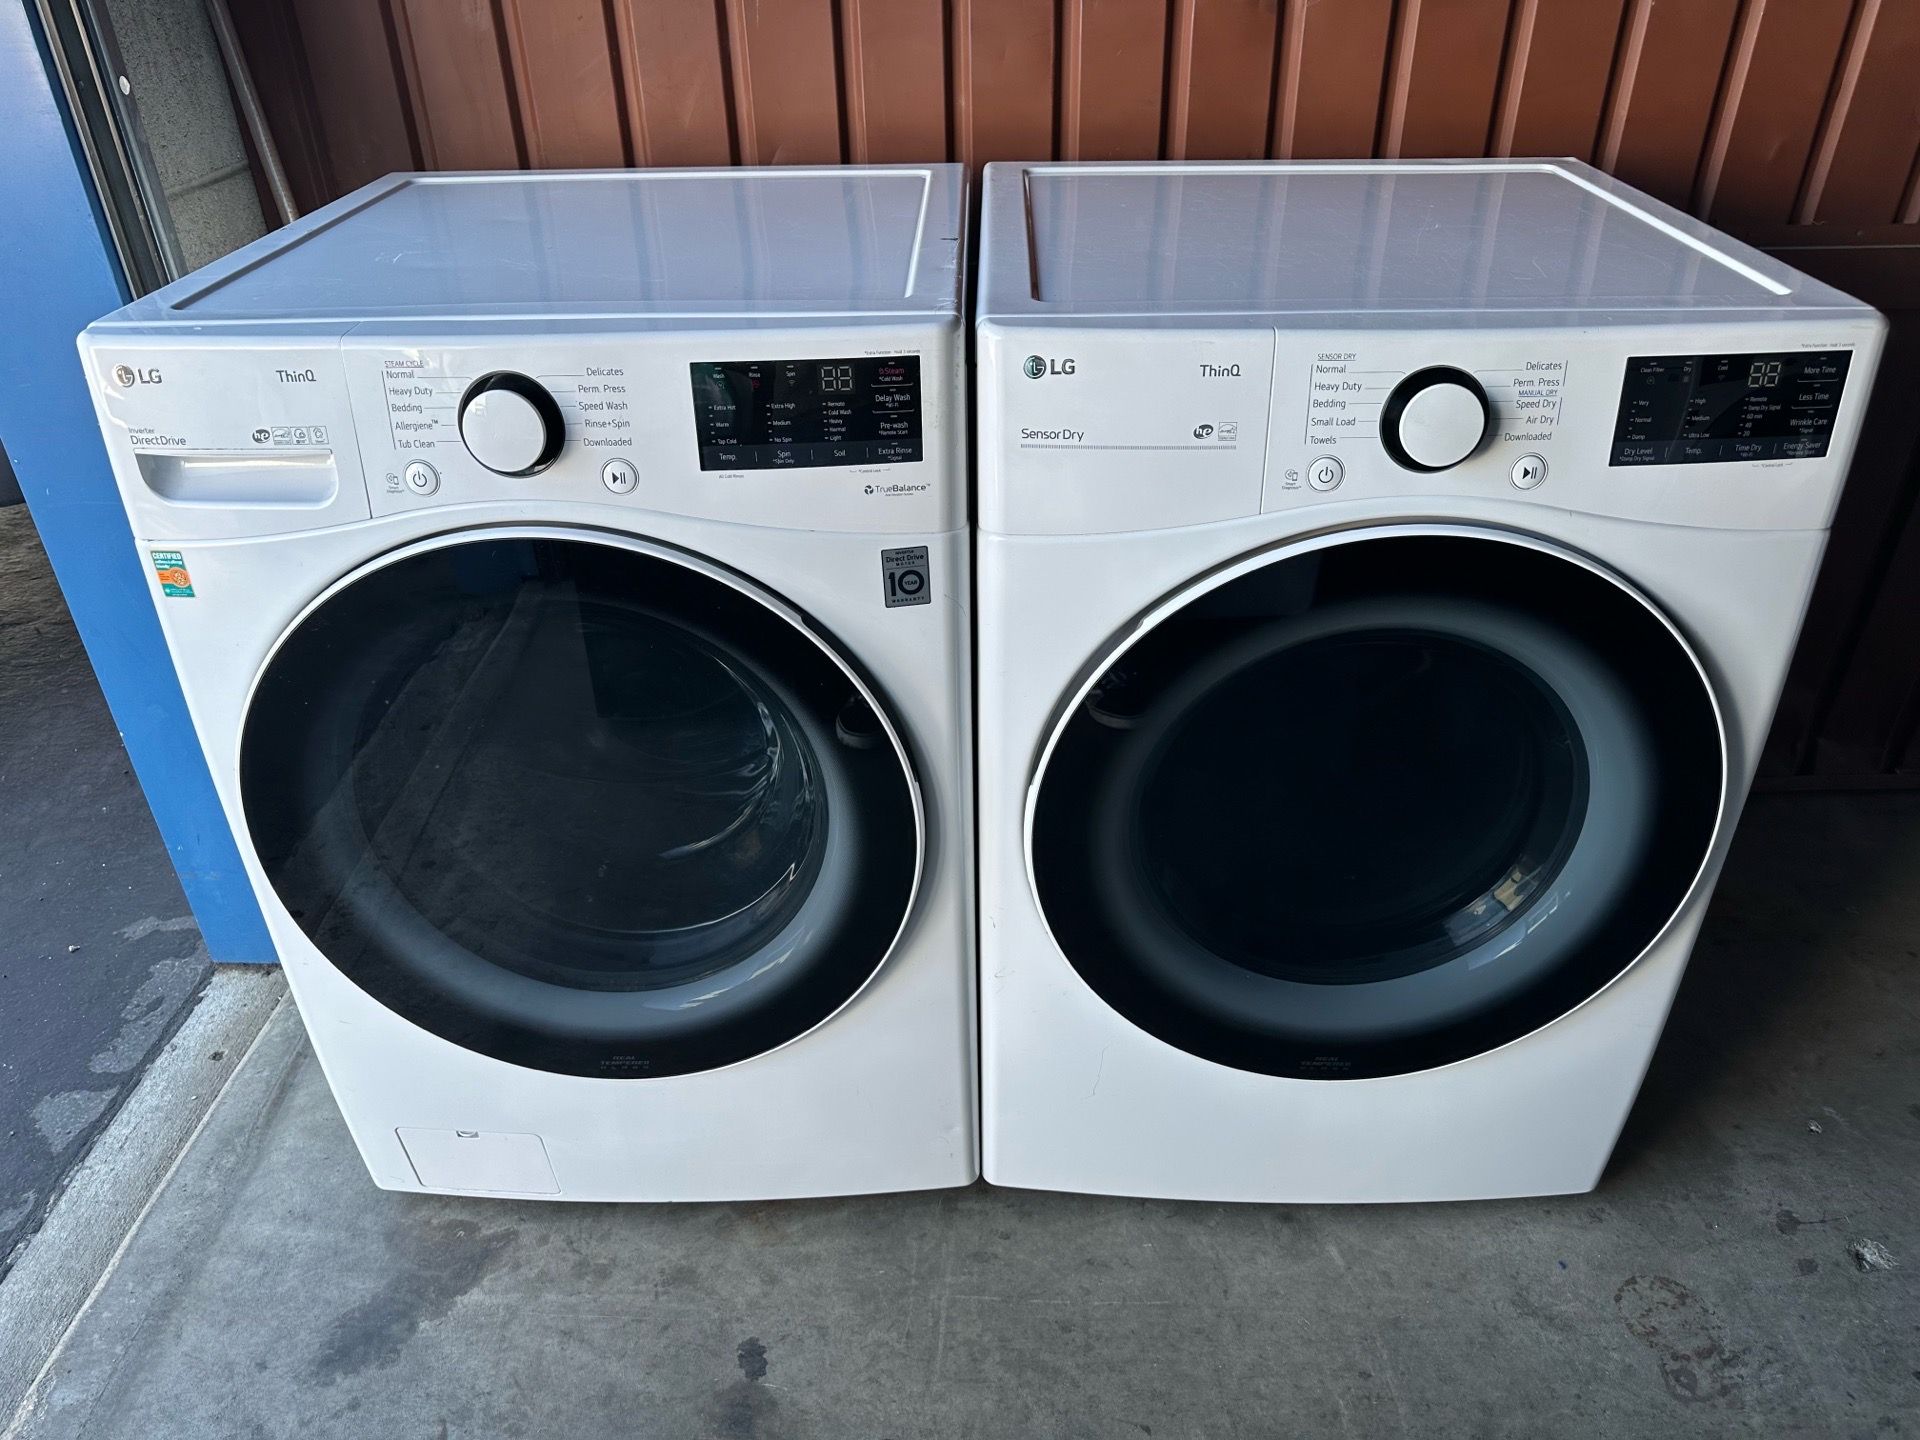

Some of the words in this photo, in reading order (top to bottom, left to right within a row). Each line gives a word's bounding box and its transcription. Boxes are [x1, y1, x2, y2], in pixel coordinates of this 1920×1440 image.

[1050, 358, 1076, 375] LG
[1200, 364, 1241, 377] ThinQ
[1316, 364, 1346, 374] Normal
[1525, 362, 1562, 372] Delicates
[138, 368, 162, 384] LG
[276, 369, 316, 383] ThinQ
[386, 370, 414, 379] Normal
[586, 368, 624, 376] Delicates
[1314, 382, 1339, 392] Heavy
[1342, 382, 1362, 392] Duty
[1513, 378, 1535, 387] Perm.
[1538, 378, 1560, 387] Press
[389, 387, 412, 397] Heavy
[414, 387, 433, 396] Duty
[578, 384, 601, 394] Perm.
[604, 384, 626, 393] Press
[392, 404, 422, 414] Bedding
[578, 402, 603, 412] Speed
[605, 402, 628, 410] Wash
[1312, 399, 1346, 410] Bedding
[1515, 400, 1540, 410] Speed
[1541, 399, 1557, 409] Dry
[584, 419, 630, 430] Rinse+Spin
[880, 421, 908, 429] Pre-wash
[1311, 417, 1333, 426] Small
[1336, 417, 1356, 426] Load
[1526, 415, 1537, 425] Air
[1539, 415, 1554, 425] Dry
[1310, 435, 1337, 444] Towels
[1504, 432, 1552, 442] Downloaded
[398, 440, 412, 448] Tub
[414, 440, 435, 448] Clean
[583, 438, 632, 447] Downloaded
[1750, 444, 1761, 452] Dry
[888, 570, 924, 596] 10
